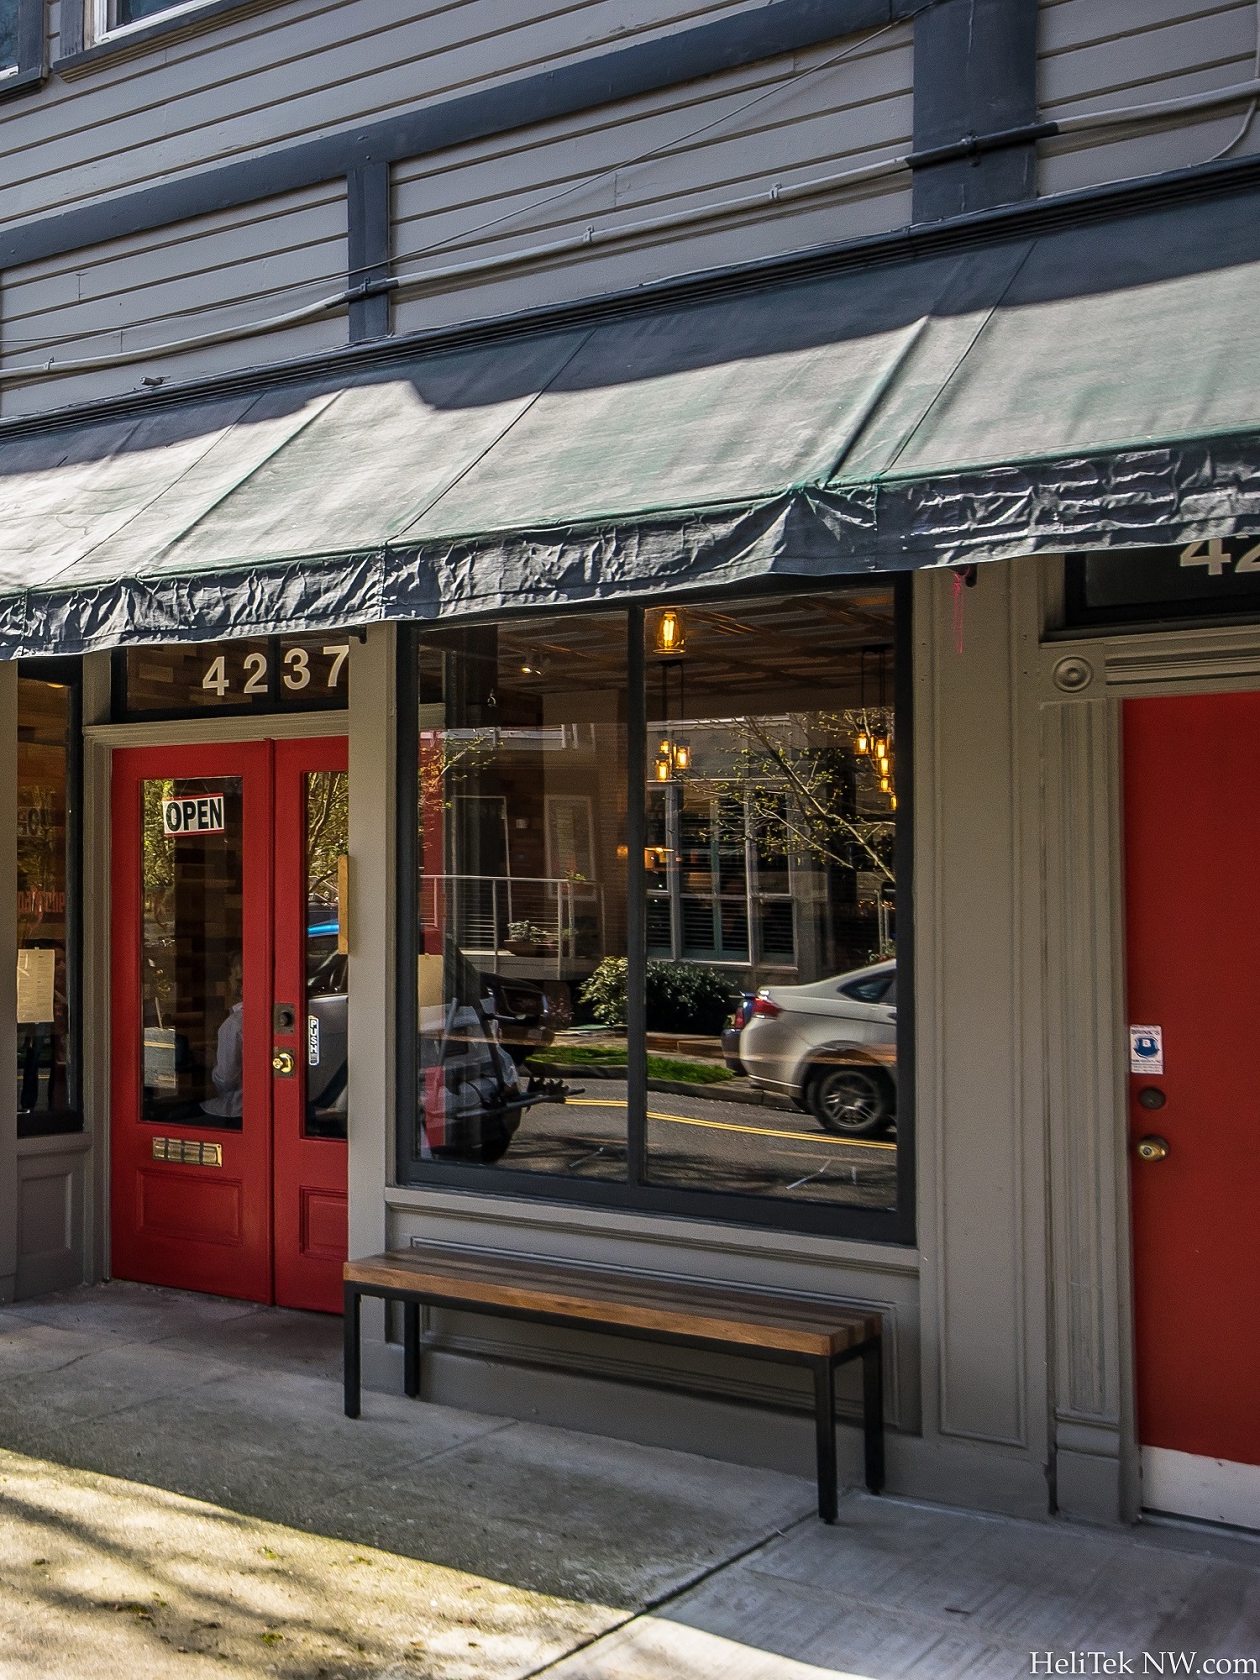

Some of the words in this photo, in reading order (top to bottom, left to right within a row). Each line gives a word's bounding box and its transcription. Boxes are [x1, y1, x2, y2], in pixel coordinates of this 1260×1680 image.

[202, 644, 350, 697] 4237
[165, 797, 223, 832] OPEN
[309, 1019, 318, 1055] PUSH
